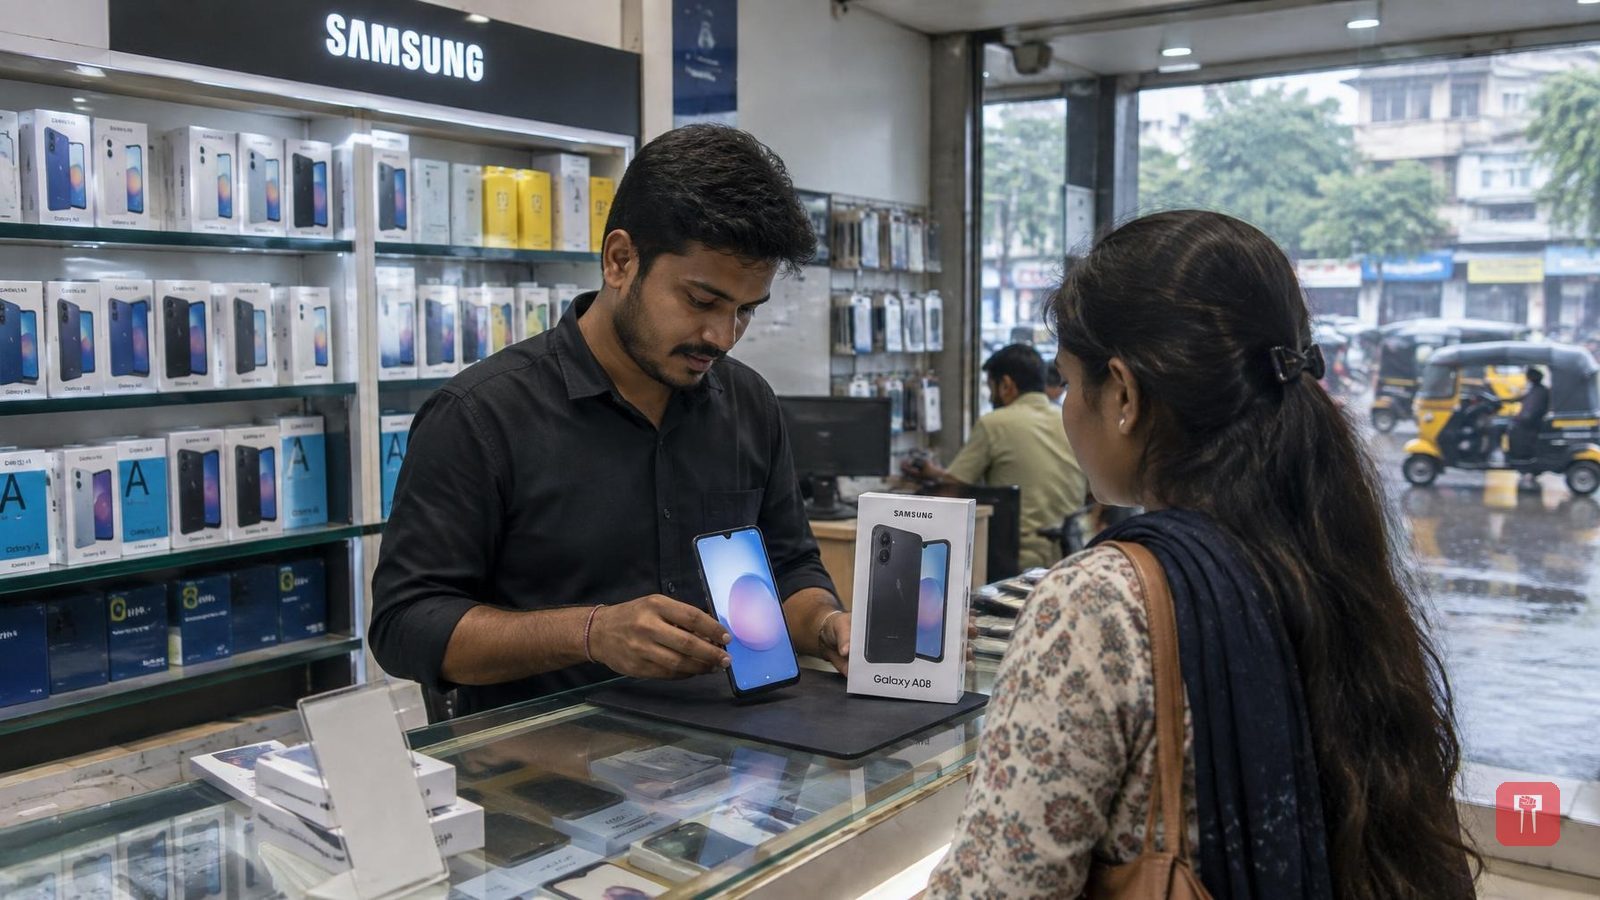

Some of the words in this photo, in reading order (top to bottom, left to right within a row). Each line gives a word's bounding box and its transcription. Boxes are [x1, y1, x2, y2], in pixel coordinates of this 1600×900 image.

[326, 13, 484, 82] SAMSUNG
[0, 473, 26, 513] A
[125, 460, 150, 497] A
[893, 510, 933, 519] SAMSUNG
[873, 674, 910, 688] Galaxy
[912, 678, 932, 688] A08
